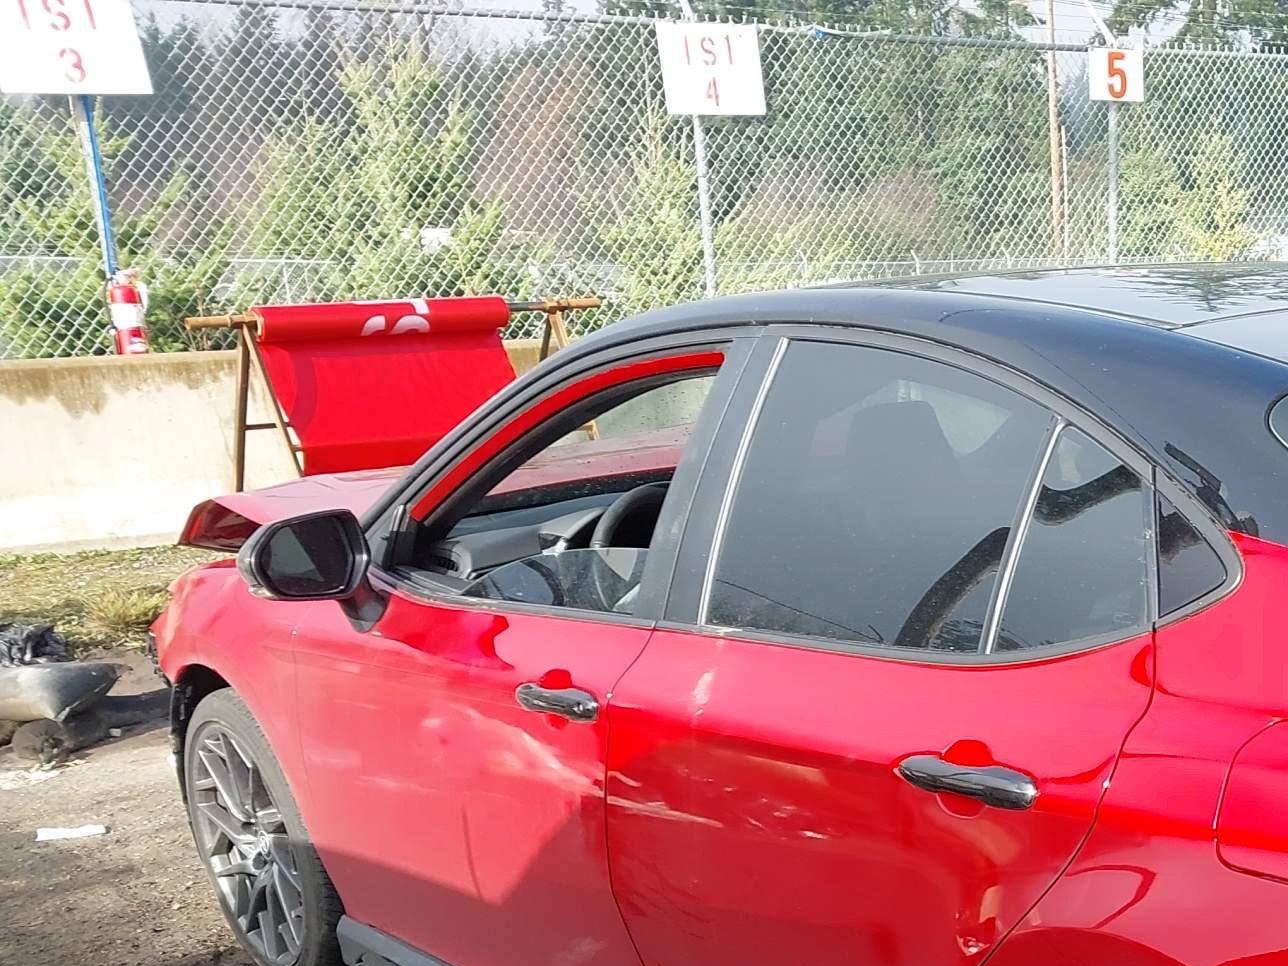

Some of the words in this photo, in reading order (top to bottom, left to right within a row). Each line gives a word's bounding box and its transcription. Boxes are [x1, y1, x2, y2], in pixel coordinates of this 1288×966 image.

[58, 47, 87, 83] 3
[1106, 51, 1128, 100] 5
[706, 77, 720, 107] 4
